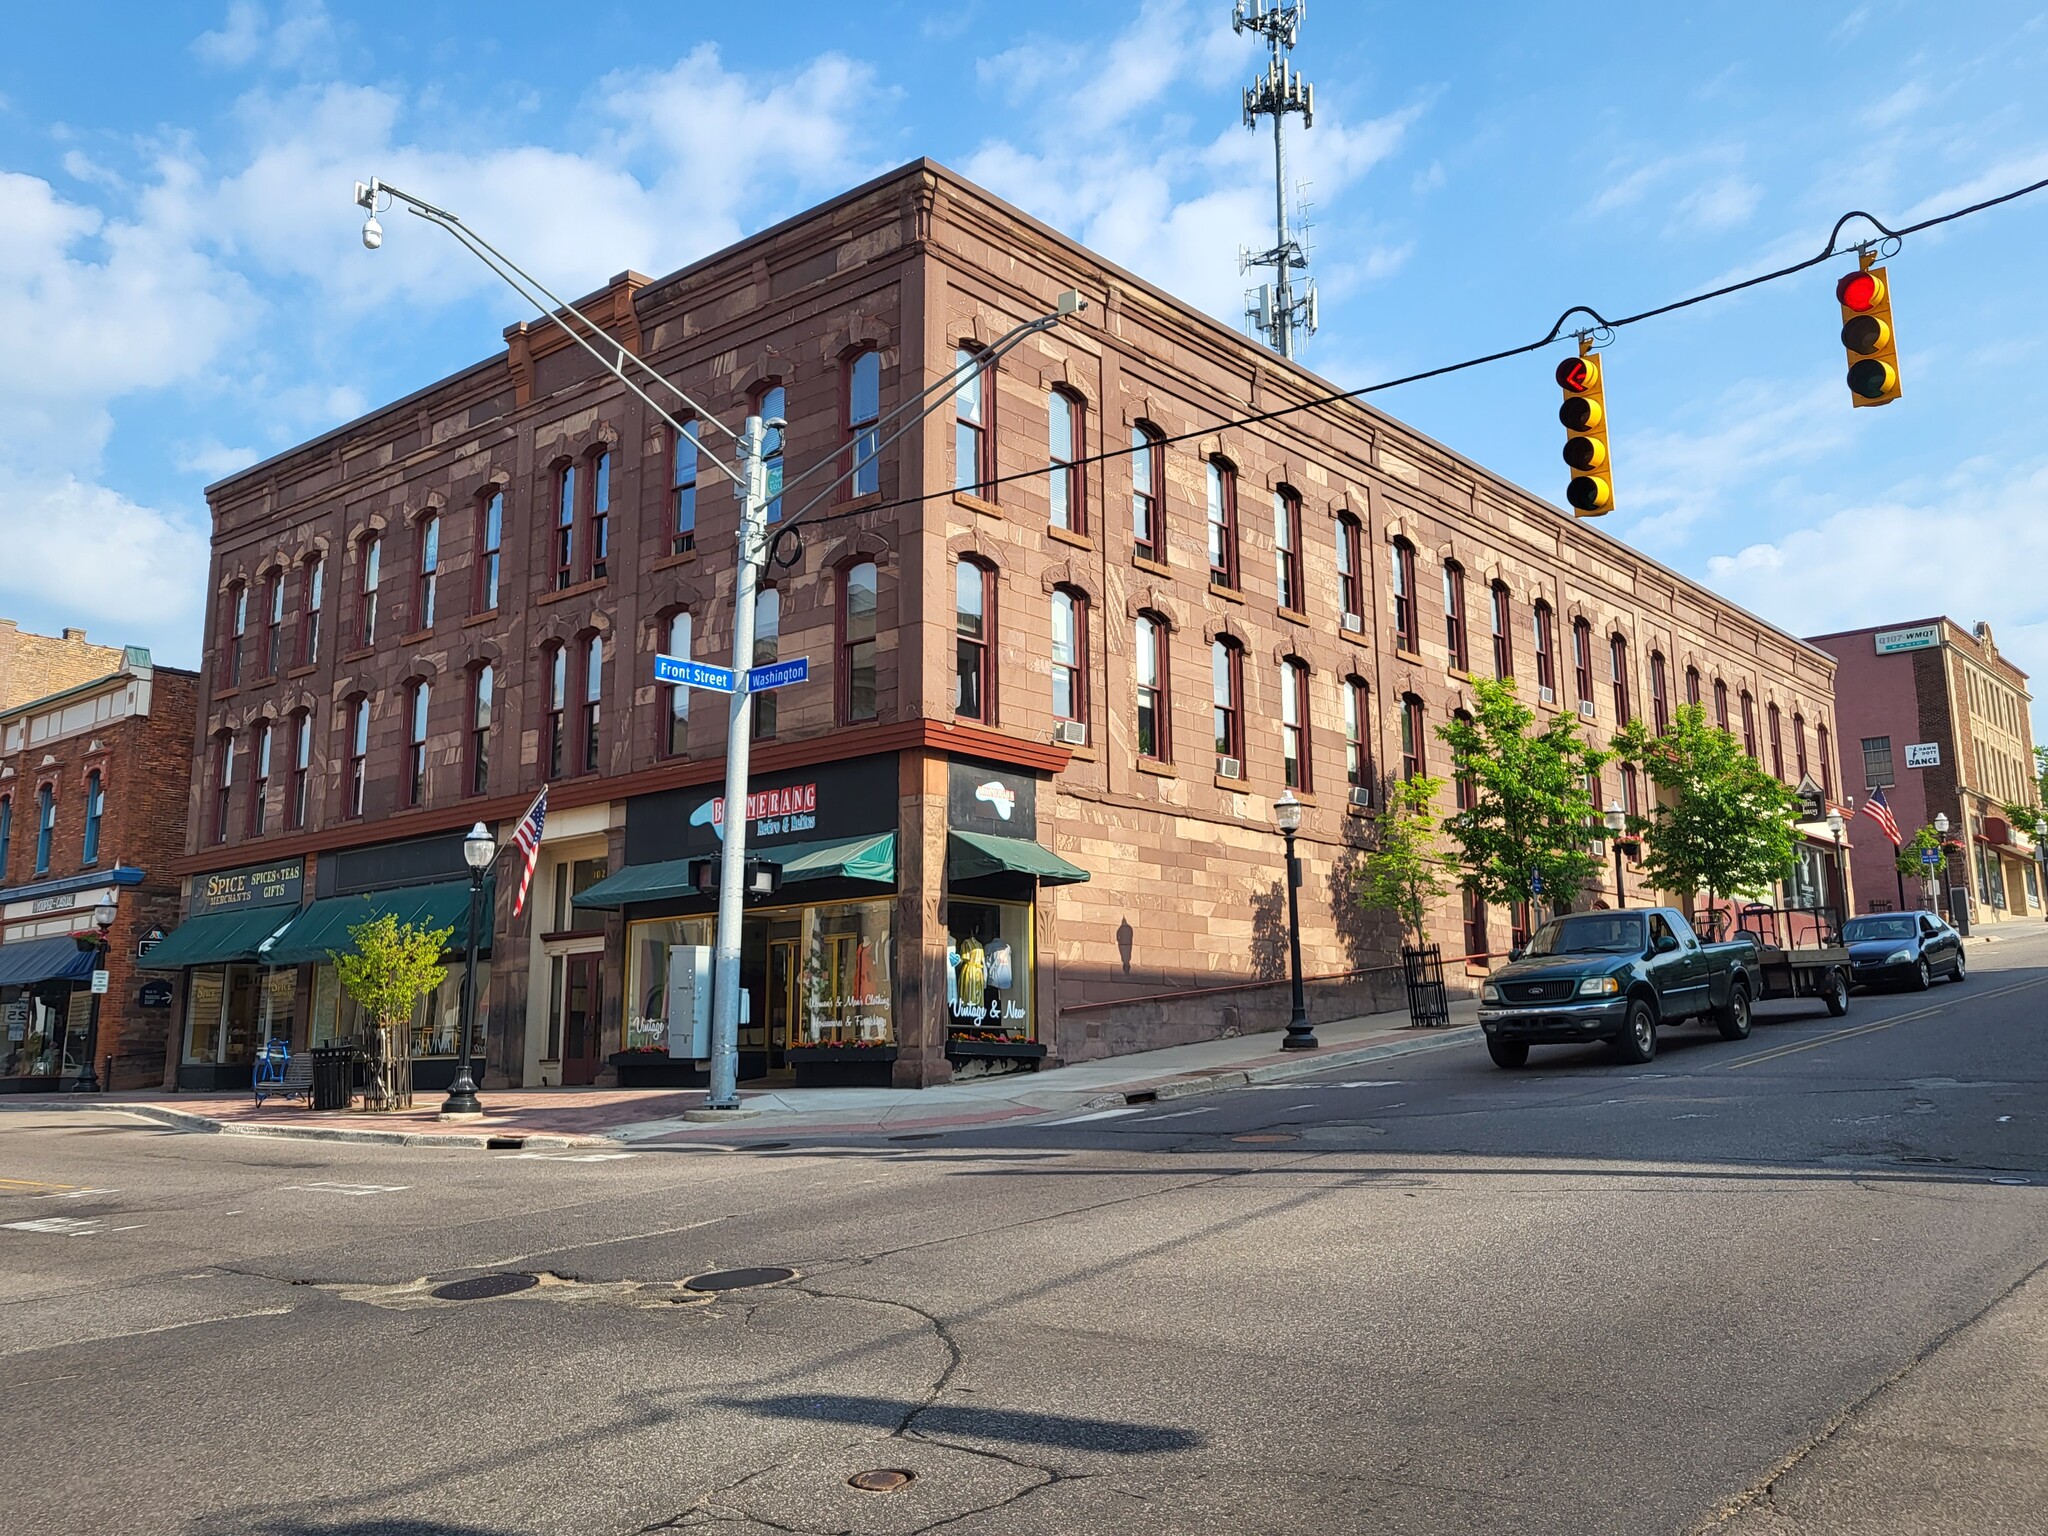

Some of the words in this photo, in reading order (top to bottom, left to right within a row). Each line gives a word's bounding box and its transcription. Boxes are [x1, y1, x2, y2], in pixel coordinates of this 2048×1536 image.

[1879, 630, 1935, 645] Q107-WMQT
[660, 662, 691, 677] Front
[693, 669, 727, 687] Street
[752, 666, 804, 687] Washington
[1908, 757, 1938, 766] DANCE
[714, 785, 816, 823] BMERANG
[251, 870, 277, 886] SPICES
[281, 866, 300, 881] TEAS
[593, 869, 606, 879] 102
[207, 875, 247, 896] SPICE
[263, 884, 285, 898] GIFTS
[210, 891, 252, 906] MERCHANTS
[835, 996, 842, 1007] &
[949, 998, 987, 1026] Vintage
[990, 1000, 1001, 1018] &
[1004, 1000, 1026, 1019] New
[633, 1016, 665, 1040] Vintage
[845, 1016, 852, 1027] &
